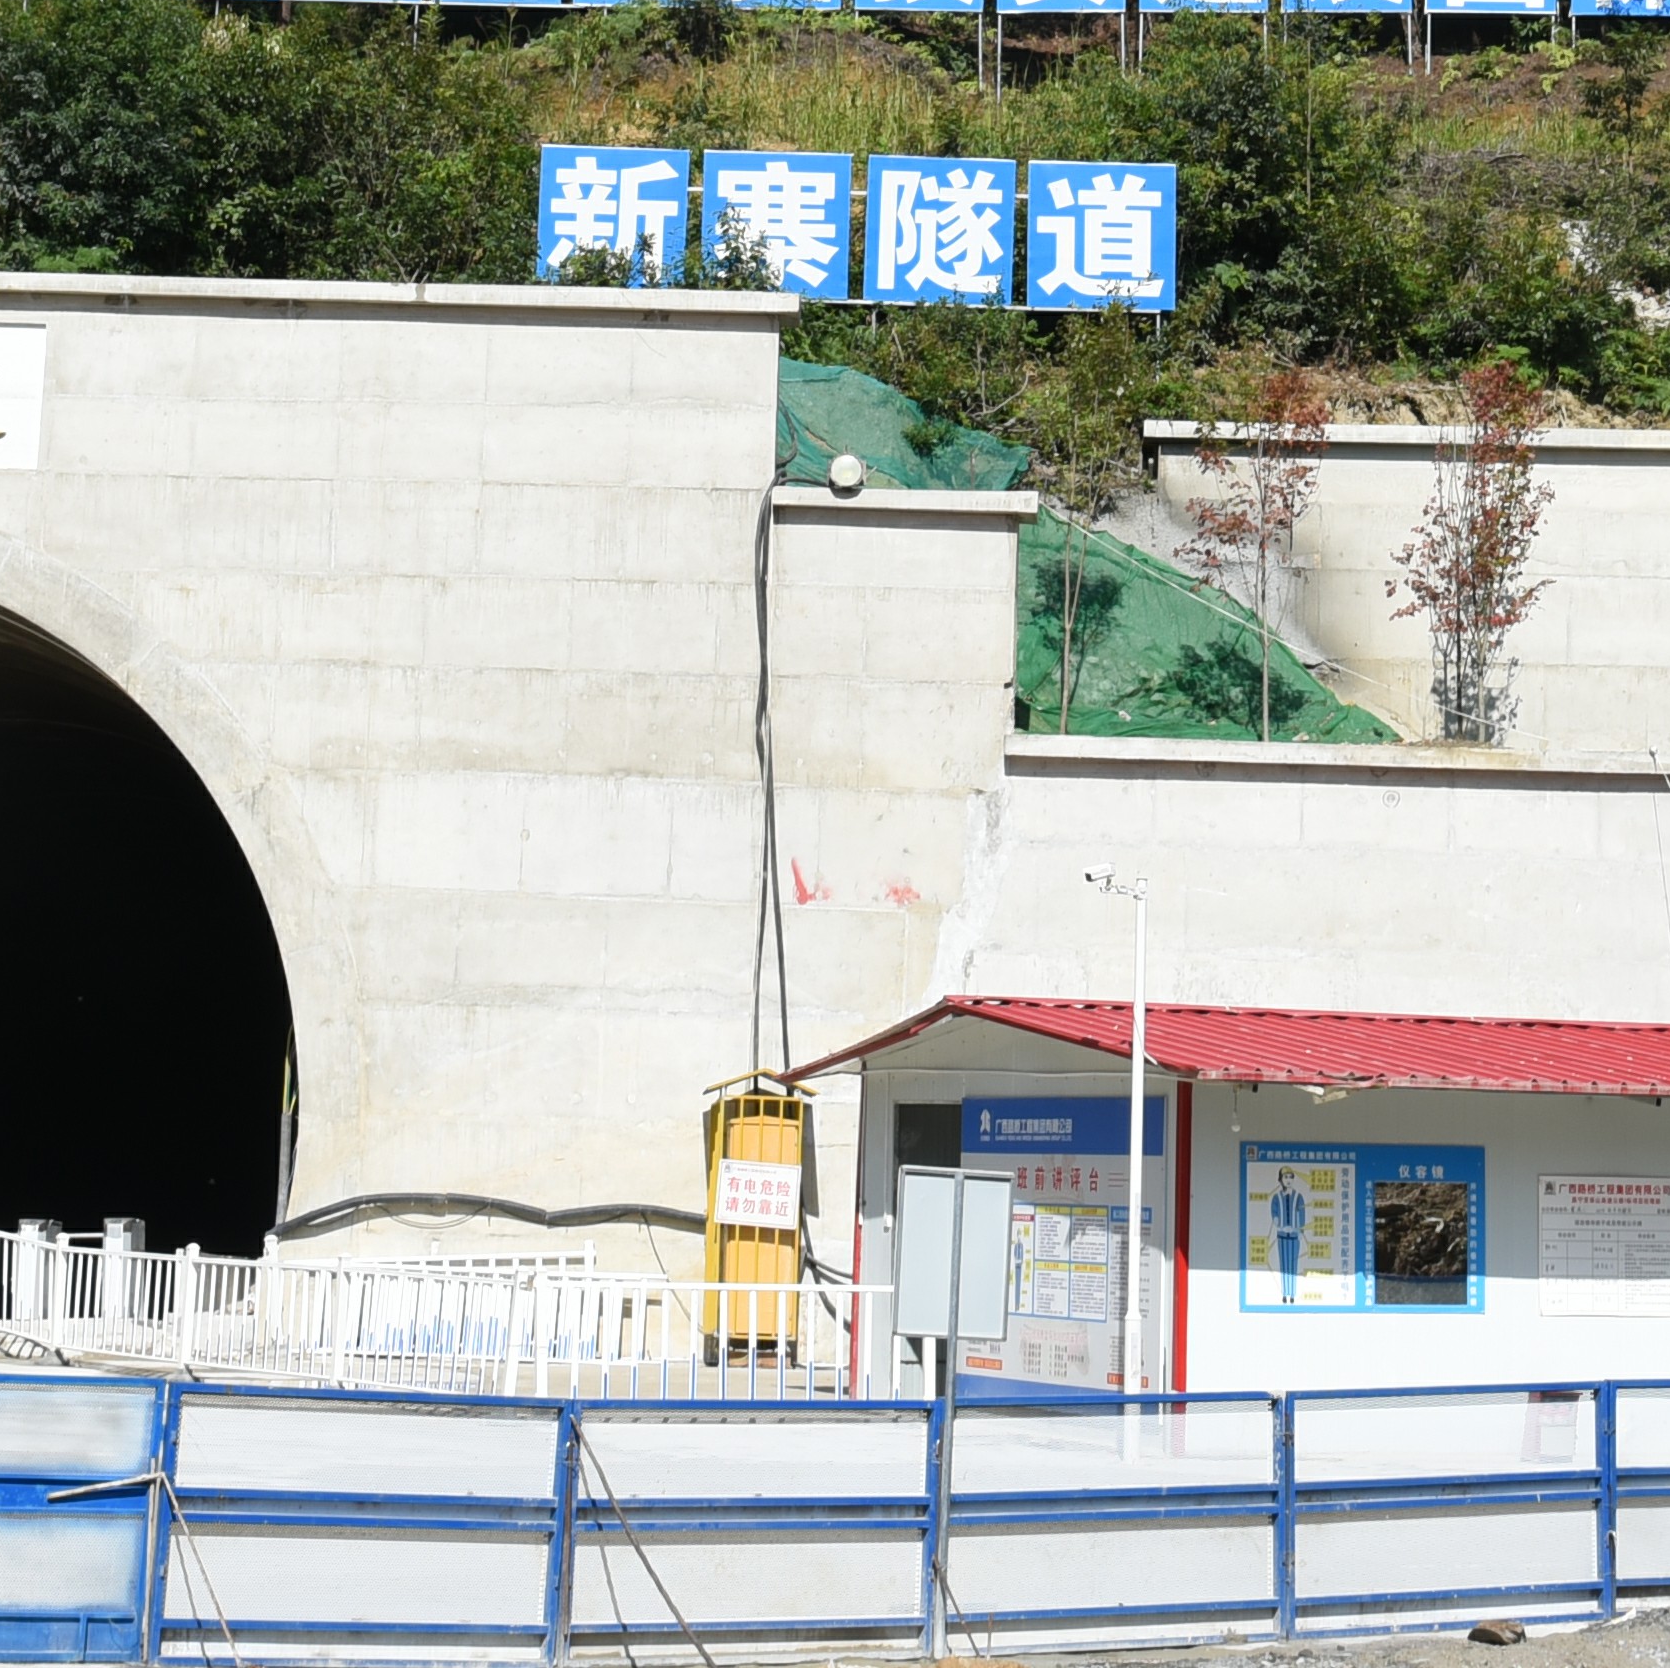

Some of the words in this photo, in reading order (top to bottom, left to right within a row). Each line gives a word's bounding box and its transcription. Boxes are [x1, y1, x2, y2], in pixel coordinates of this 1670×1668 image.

[547, 156, 1165, 298] 新寨隧道
[1258, 1150, 1356, 1162] 广西路桥工程集团有限公司
[1017, 1166, 1100, 1192] 班前讲评台
[1399, 1165, 1444, 1179] 仪容镜
[727, 1176, 791, 1197] 有电危险
[1558, 1184, 1670, 1196] 广西路桥工程集团有限公司
[725, 1196, 789, 1217] 请勿靠近
